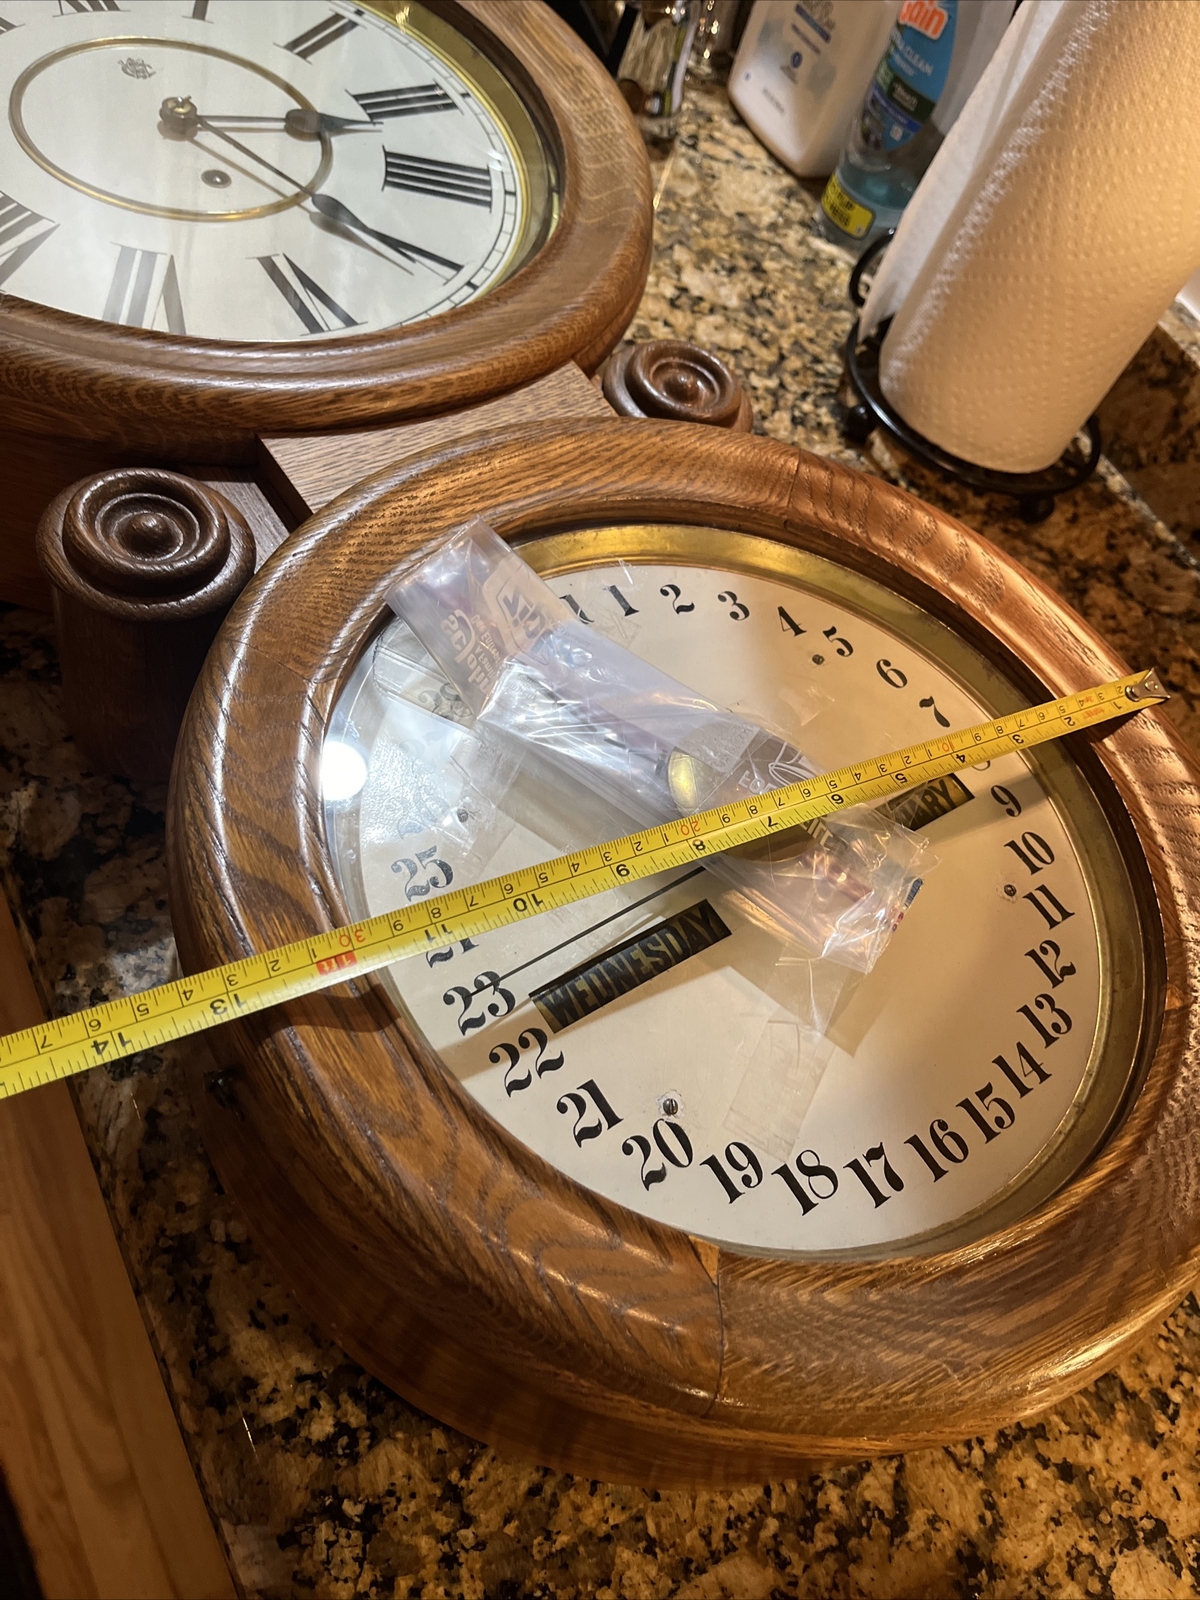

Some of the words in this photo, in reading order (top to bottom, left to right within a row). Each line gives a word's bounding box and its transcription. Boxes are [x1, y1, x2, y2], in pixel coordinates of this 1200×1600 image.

[345, 78, 464, 126] III
[381, 144, 492, 214] IIII
[659, 584, 695, 615] 2
[718, 590, 750, 621] 3
[776, 606, 807, 637] 4
[823, 626, 854, 657] 5
[876, 659, 908, 689] 6
[1059, 705, 1066, 714] 5
[1078, 699, 1084, 707] 4
[1113, 701, 1122, 710] 1
[919, 696, 950, 728] 7
[1038, 712, 1046, 720] 6
[1019, 719, 1025, 728] 7
[1064, 716, 1076, 727] 2
[996, 725, 1004, 734] 8
[974, 733, 982, 742] 9
[1012, 734, 1024, 745] 3
[904, 755, 912, 765] 2
[956, 753, 966, 763] 4
[879, 763, 888, 773] 3
[854, 772, 862, 781] 4
[894, 773, 908, 784] 5
[829, 780, 838, 789] 5
[802, 788, 811, 798] 6
[831, 793, 845, 805] 6
[777, 797, 785, 807] 7
[990, 785, 1022, 817] 9
[749, 805, 758, 815] 8
[722, 813, 731, 824] 9
[767, 816, 779, 828] 7
[680, 820, 701, 836] 20
[633, 841, 643, 852] 2
[692, 839, 706, 851] 8
[603, 851, 613, 862] 3
[1004, 832, 1055, 875] 10
[390, 845, 454, 902] 25
[571, 862, 580, 873] 4
[615, 863, 630, 877] 9
[538, 872, 549, 883] 5
[503, 883, 514, 895] 6
[469, 895, 479, 907] 7
[513, 893, 544, 912] 10
[1022, 884, 1075, 930] 11
[430, 907, 442, 919] 8
[392, 920, 404, 932] 9
[338, 929, 366, 947] 30
[269, 959, 281, 972] 2
[535, 908, 723, 1030] WEDNESDAY
[1024, 939, 1077, 989] 12
[226, 973, 239, 986] 3
[182, 988, 195, 1001] 4
[137, 1003, 150, 1017] 5
[209, 993, 246, 1016] 13
[443, 971, 516, 1036] 23
[89, 1018, 102, 1032] 6
[1016, 993, 1072, 1048] 13
[41, 1034, 54, 1049] 7
[91, 1031, 132, 1056] 14
[489, 1027, 564, 1097] 22
[992, 1041, 1052, 1099] 14
[556, 1079, 624, 1148] 21
[956, 1082, 1016, 1144] 15
[621, 1118, 693, 1191] 20
[904, 1119, 969, 1183] 16
[700, 1141, 763, 1204] 19
[843, 1142, 904, 1209] 17
[771, 1149, 839, 1216] 18
